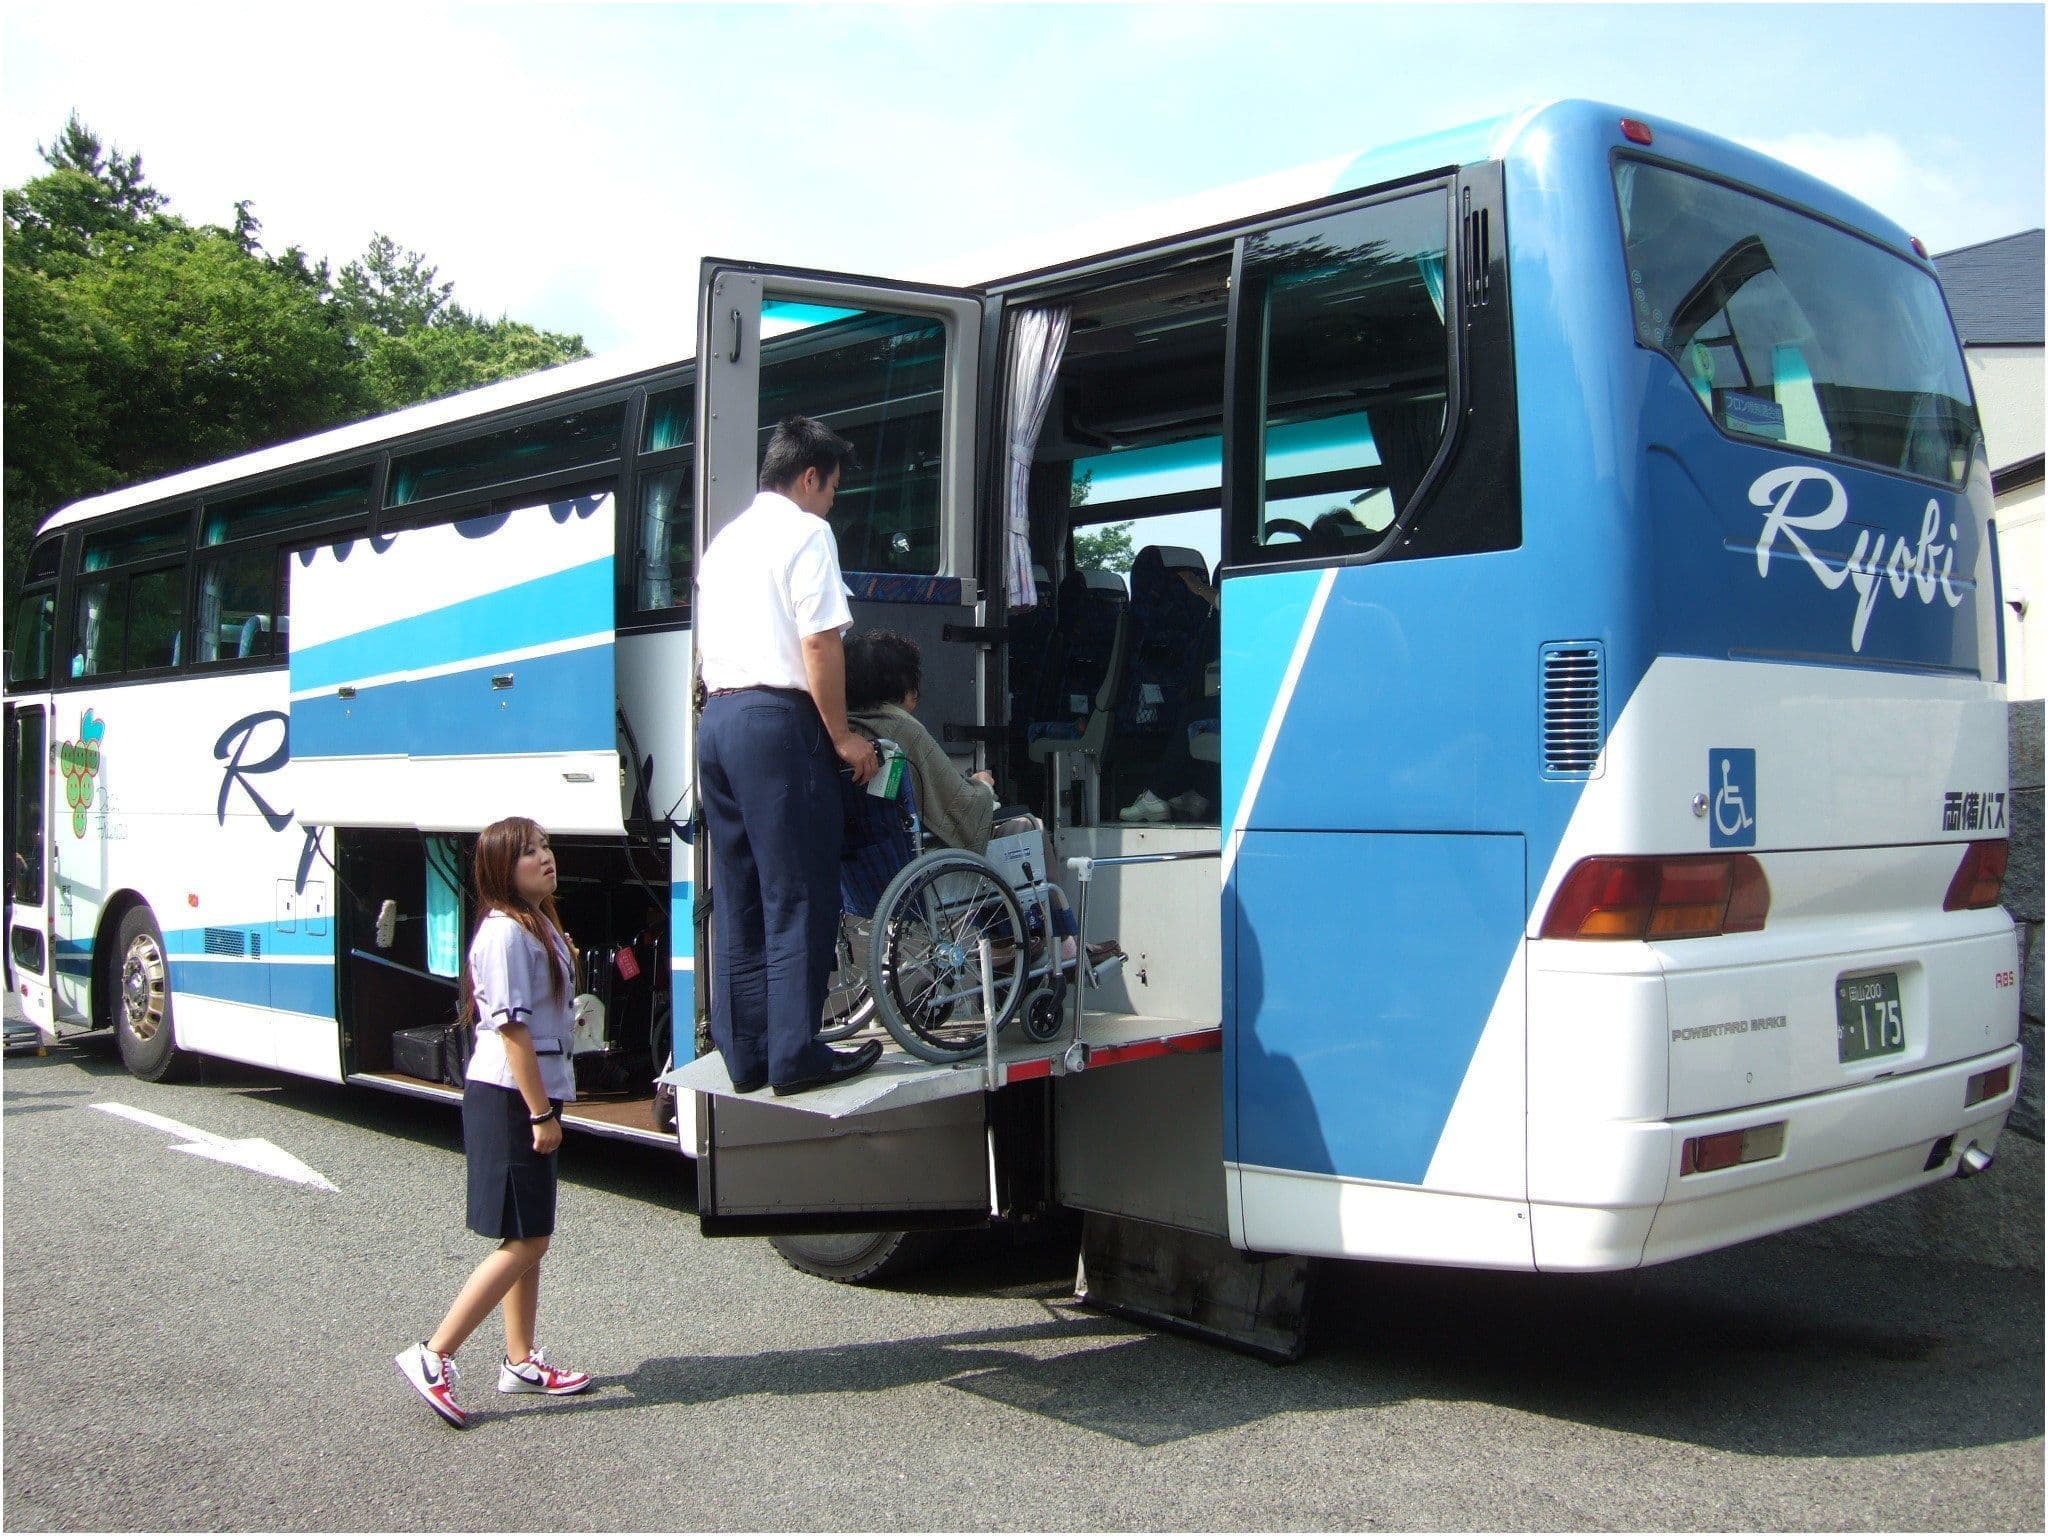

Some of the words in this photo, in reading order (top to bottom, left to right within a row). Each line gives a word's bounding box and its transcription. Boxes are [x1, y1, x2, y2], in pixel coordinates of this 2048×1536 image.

[1747, 466, 1965, 653] Ryobi
[1942, 790, 2006, 832] 両備バス
[1995, 970, 2014, 989] ABS
[1750, 1015, 1787, 1032] BRAKE
